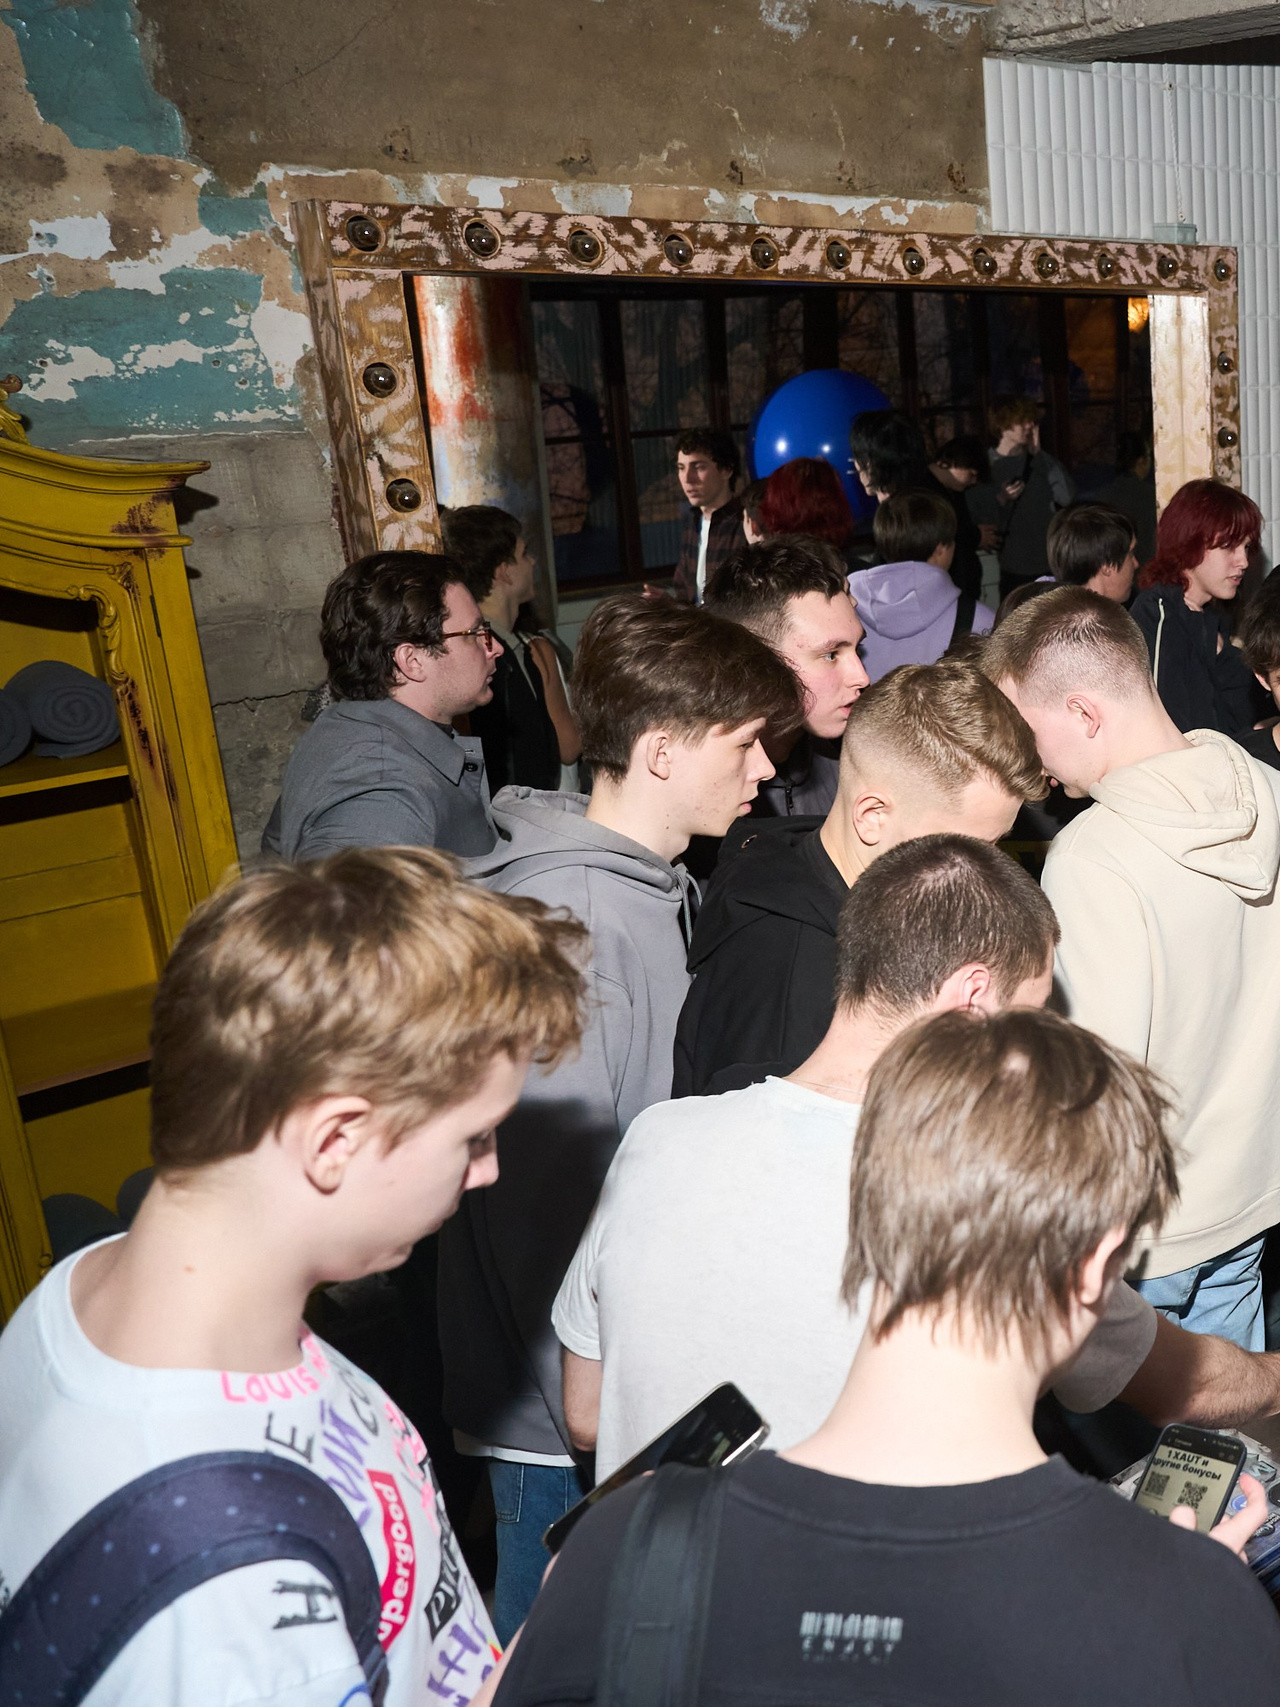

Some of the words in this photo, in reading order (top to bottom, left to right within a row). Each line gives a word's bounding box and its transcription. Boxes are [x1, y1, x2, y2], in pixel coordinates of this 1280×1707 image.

[1173, 1451, 1202, 1464] XAUT
[1182, 1463, 1221, 1480] бонусы
[373, 1483, 415, 1642] upergood
